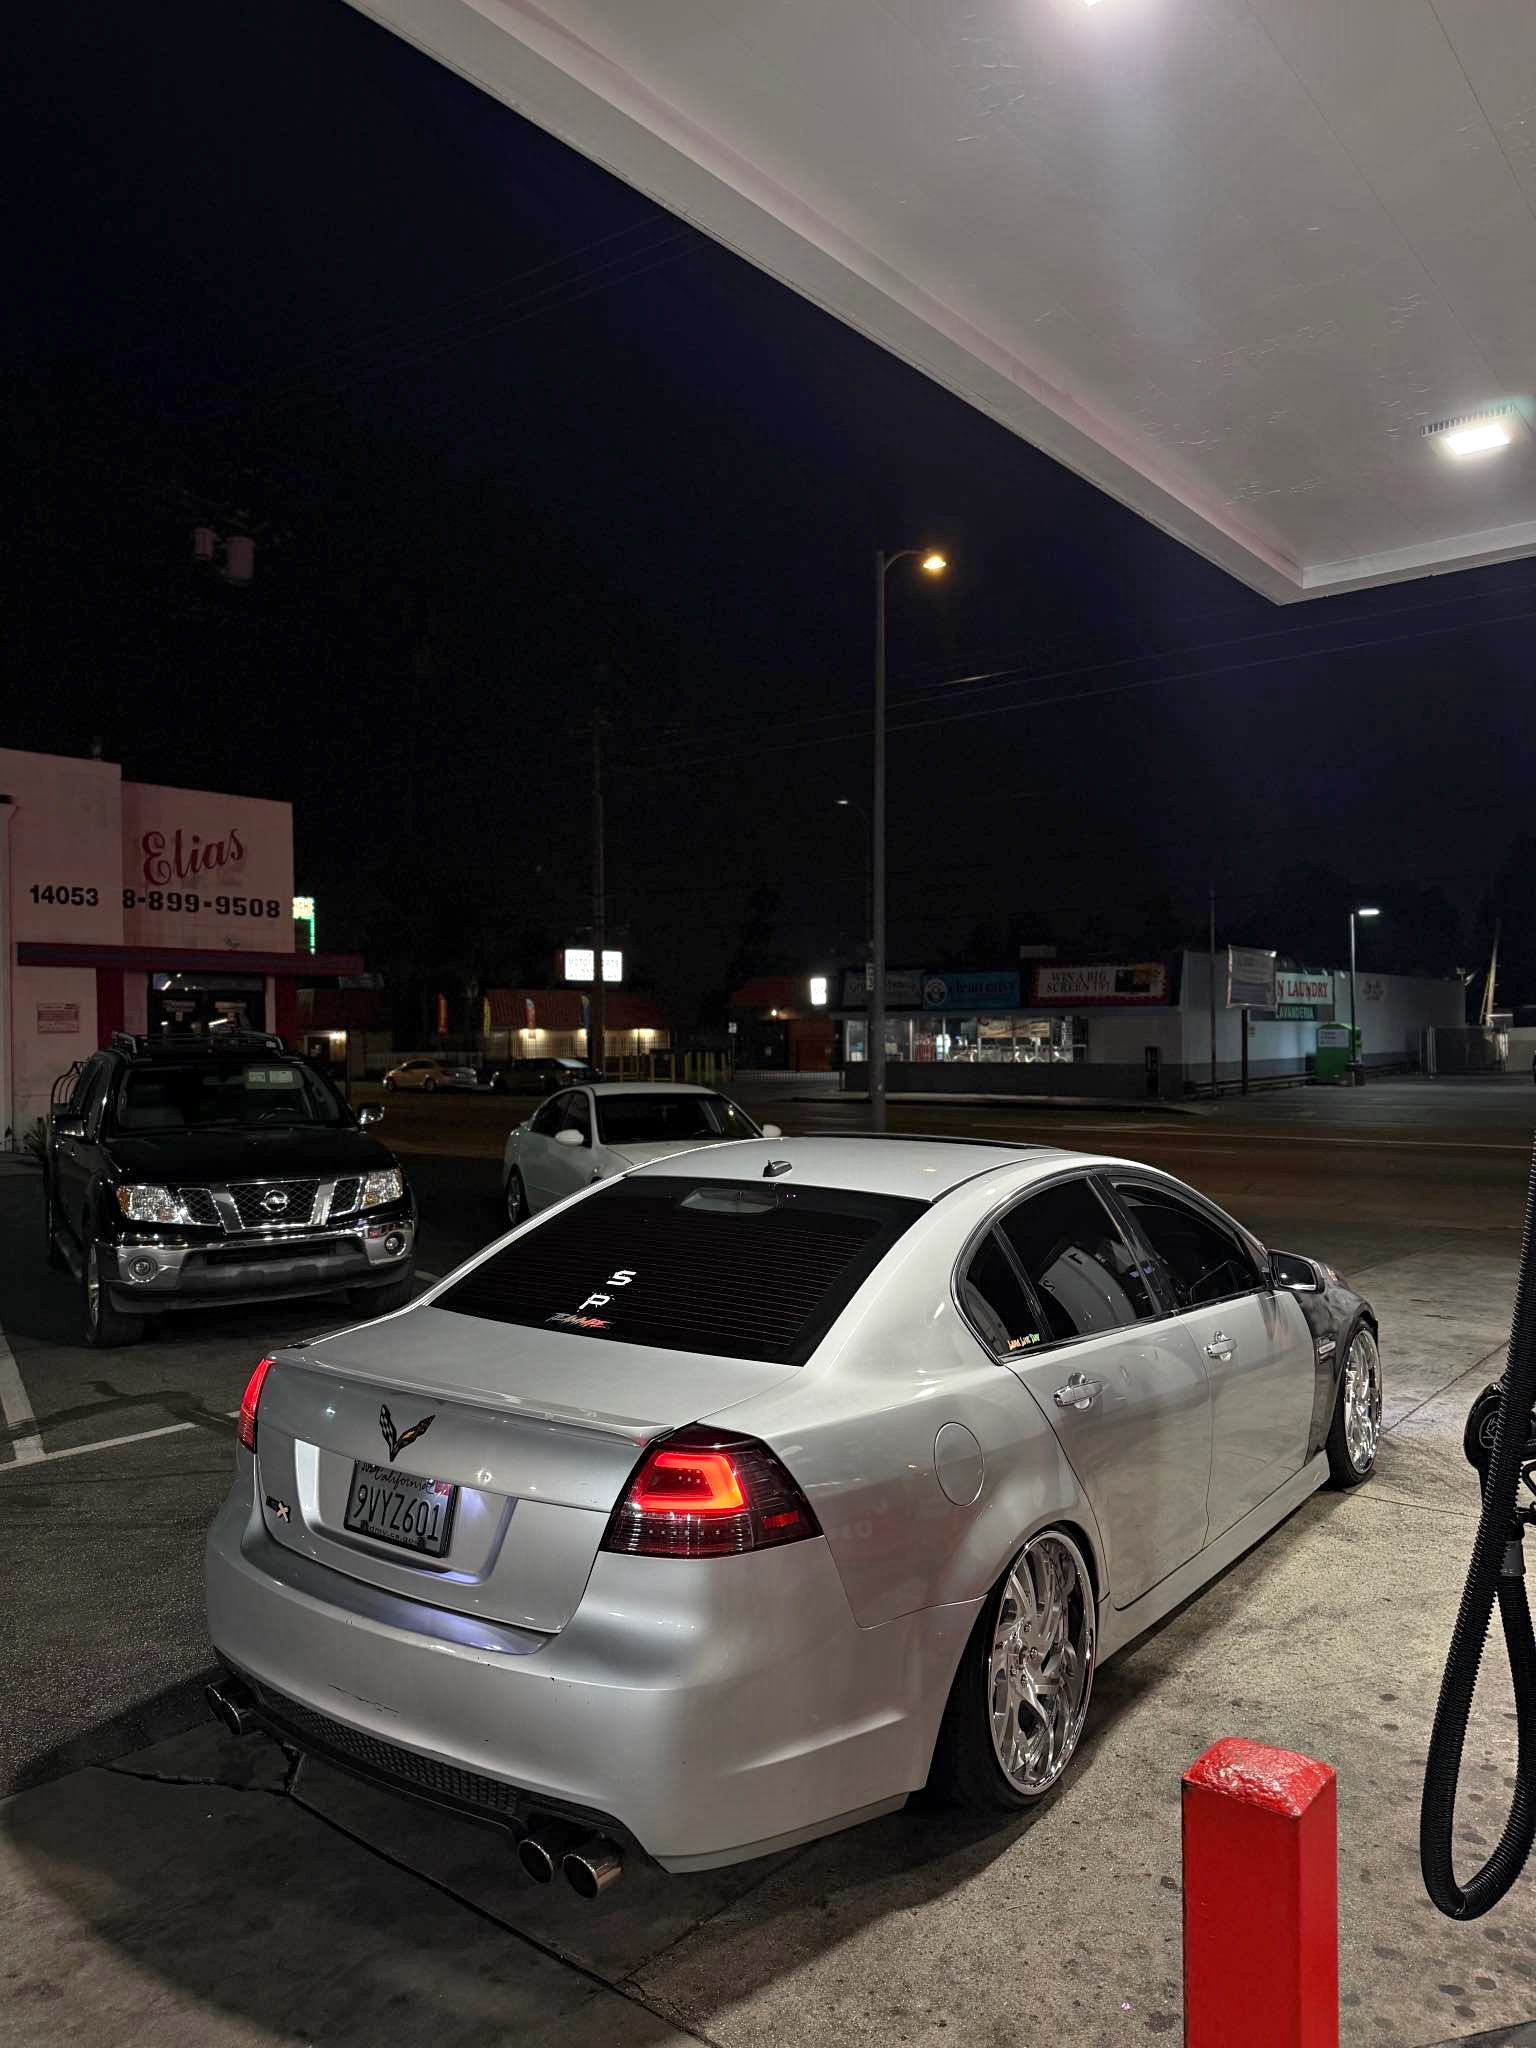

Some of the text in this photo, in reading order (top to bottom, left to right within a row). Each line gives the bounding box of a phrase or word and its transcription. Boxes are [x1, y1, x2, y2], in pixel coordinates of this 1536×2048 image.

[142, 828, 244, 885] Elias
[30, 885, 99, 906] 14053
[1287, 980, 1328, 998] LAUNDRY
[606, 1269, 637, 1286] S
[579, 1293, 611, 1310] P
[353, 1484, 442, 1542] 9VYZ601
